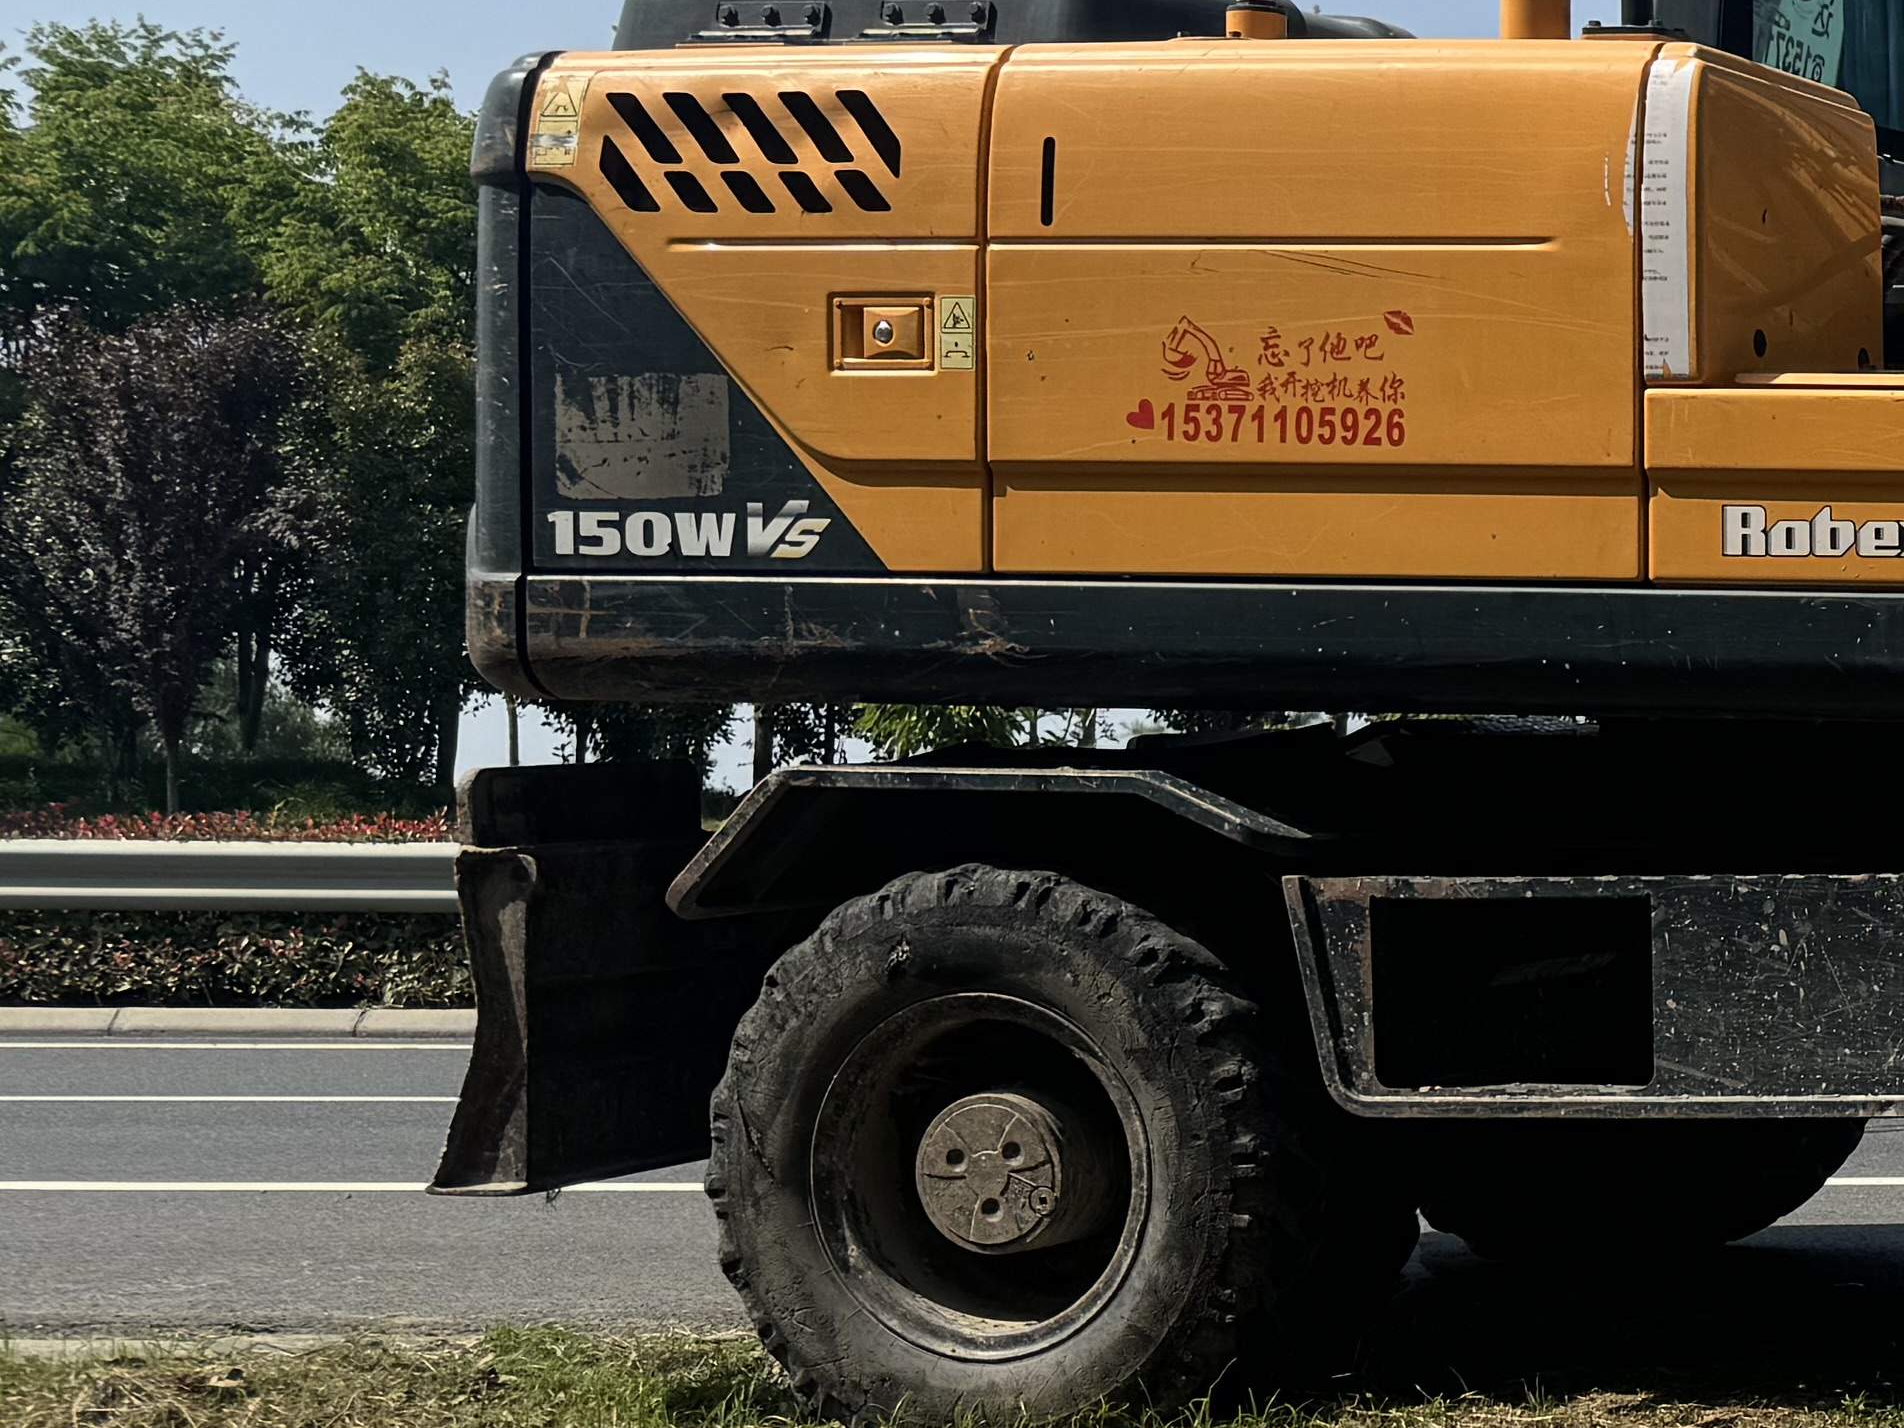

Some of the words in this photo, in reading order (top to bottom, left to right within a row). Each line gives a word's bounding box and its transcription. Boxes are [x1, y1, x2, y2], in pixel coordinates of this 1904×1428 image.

[1257, 326, 1386, 368] 忘了他吧
[1256, 371, 1406, 406] 我开挖机养你
[1160, 401, 1406, 448] 15371105926
[546, 510, 737, 558] 150W
